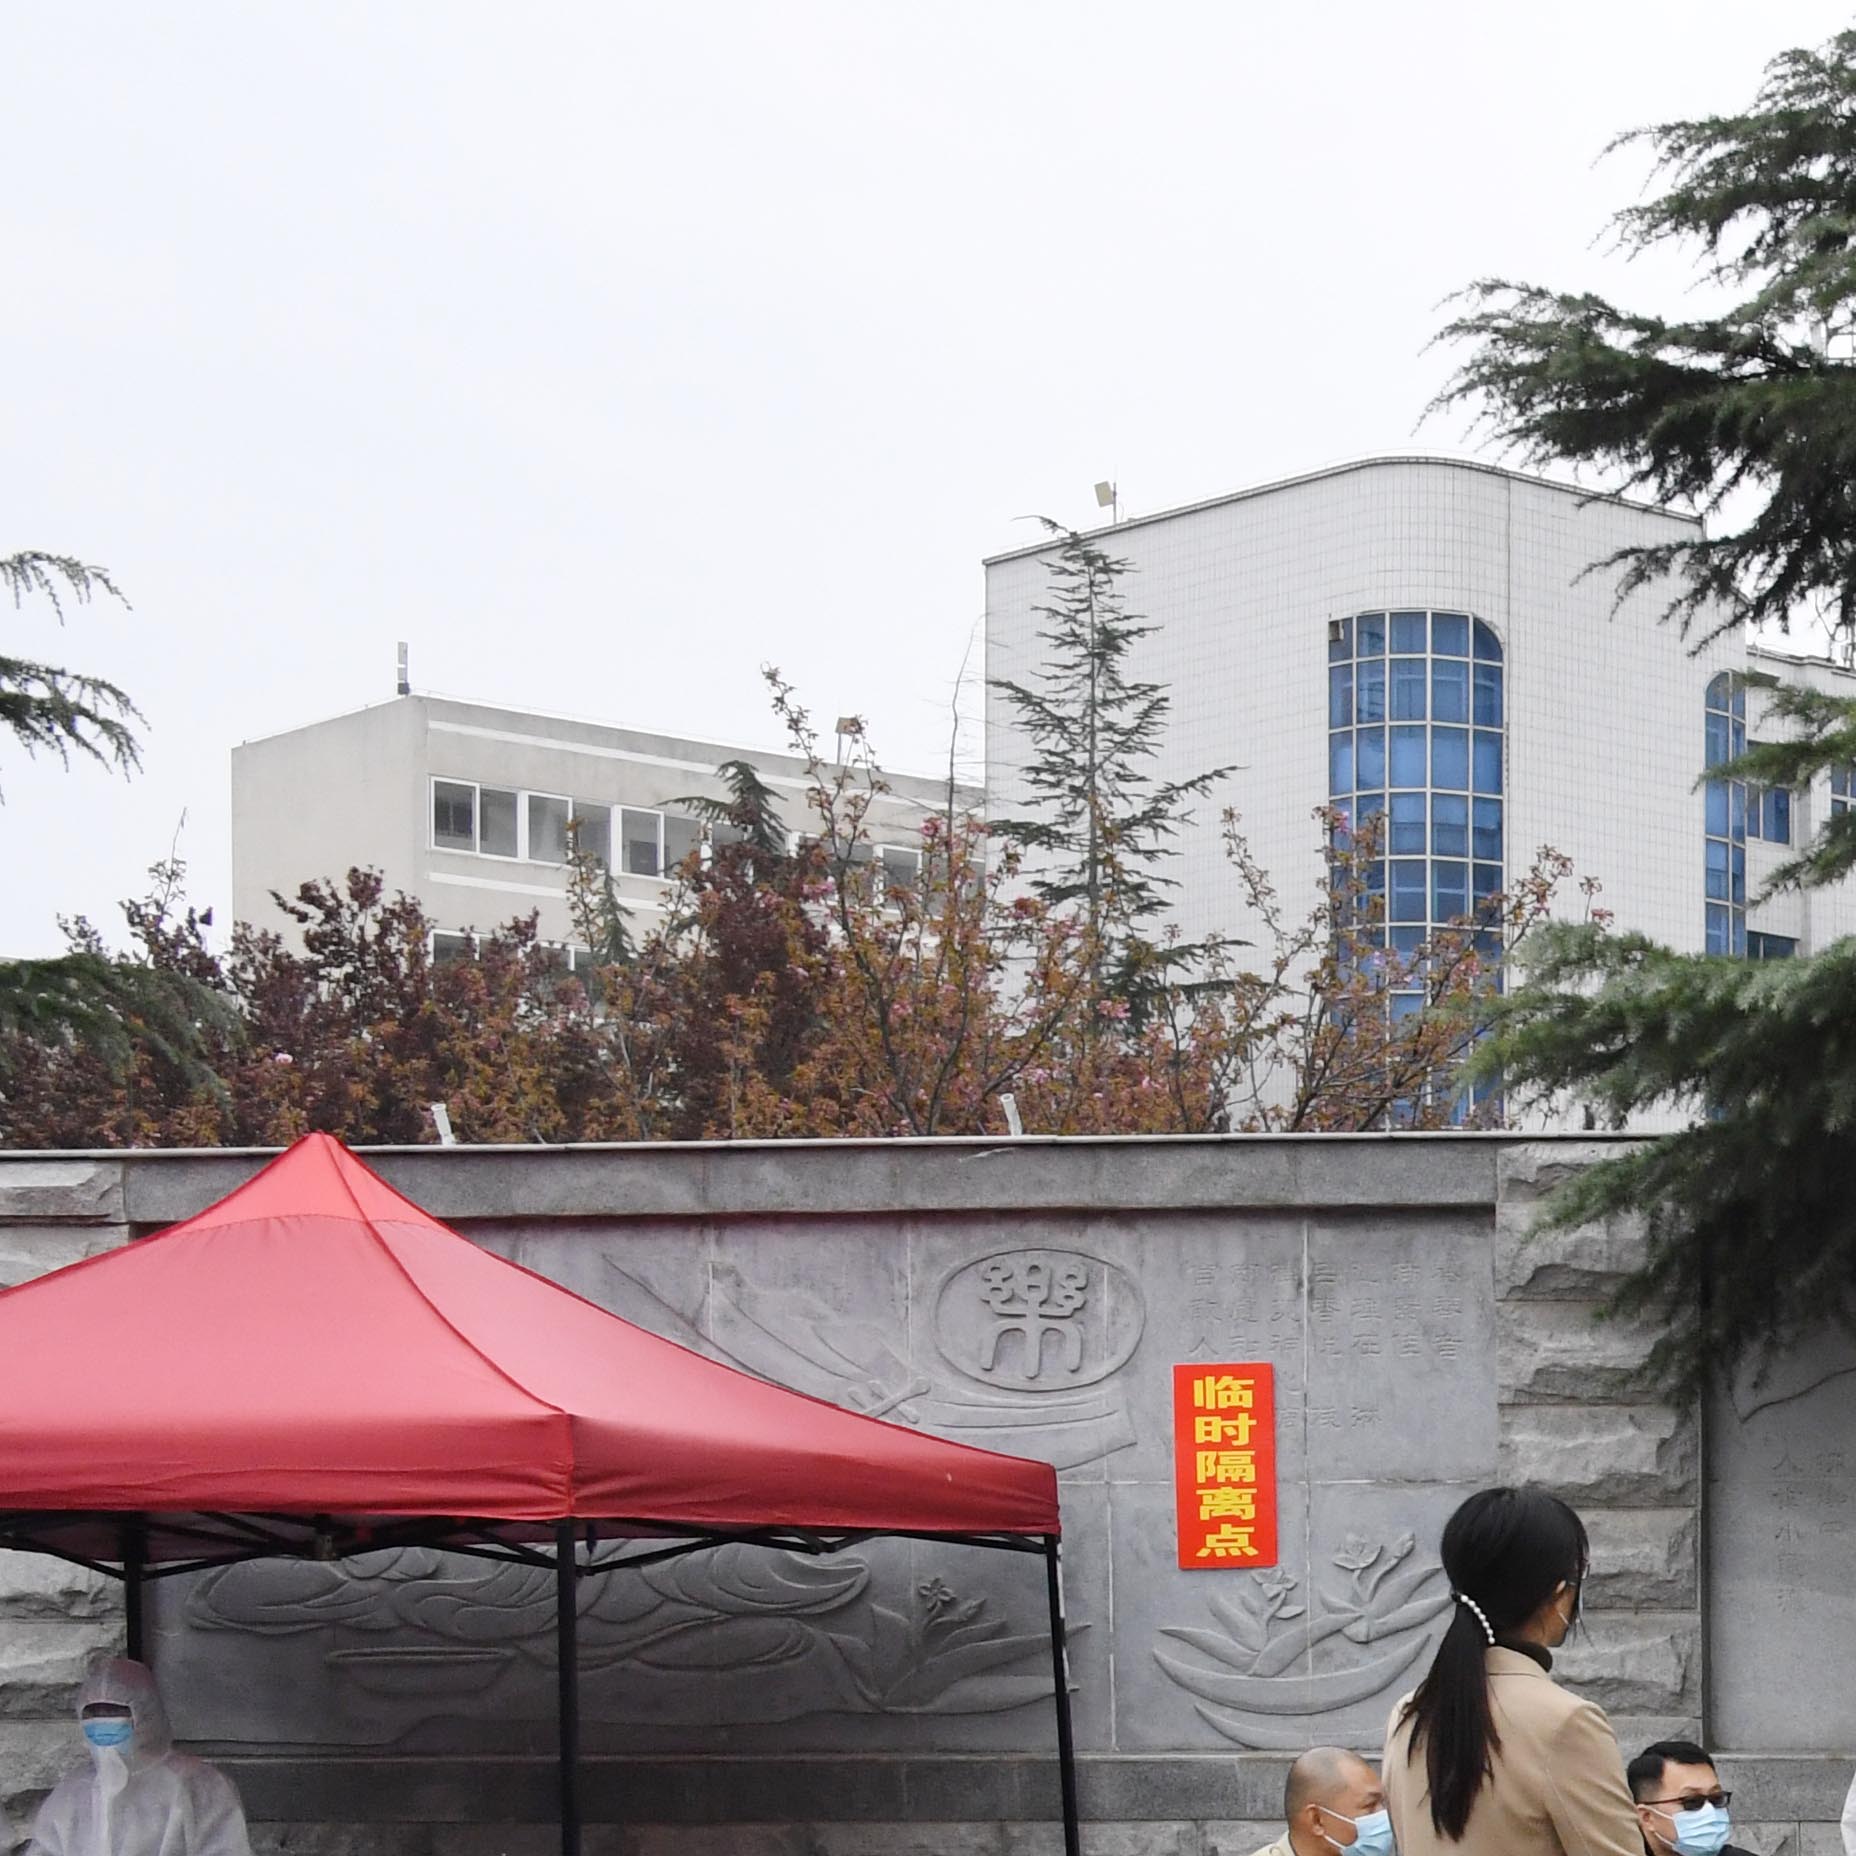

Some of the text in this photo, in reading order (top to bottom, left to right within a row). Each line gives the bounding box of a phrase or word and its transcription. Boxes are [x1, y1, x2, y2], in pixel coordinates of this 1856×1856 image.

[1193, 1376, 1259, 1557] 临时隔离点
